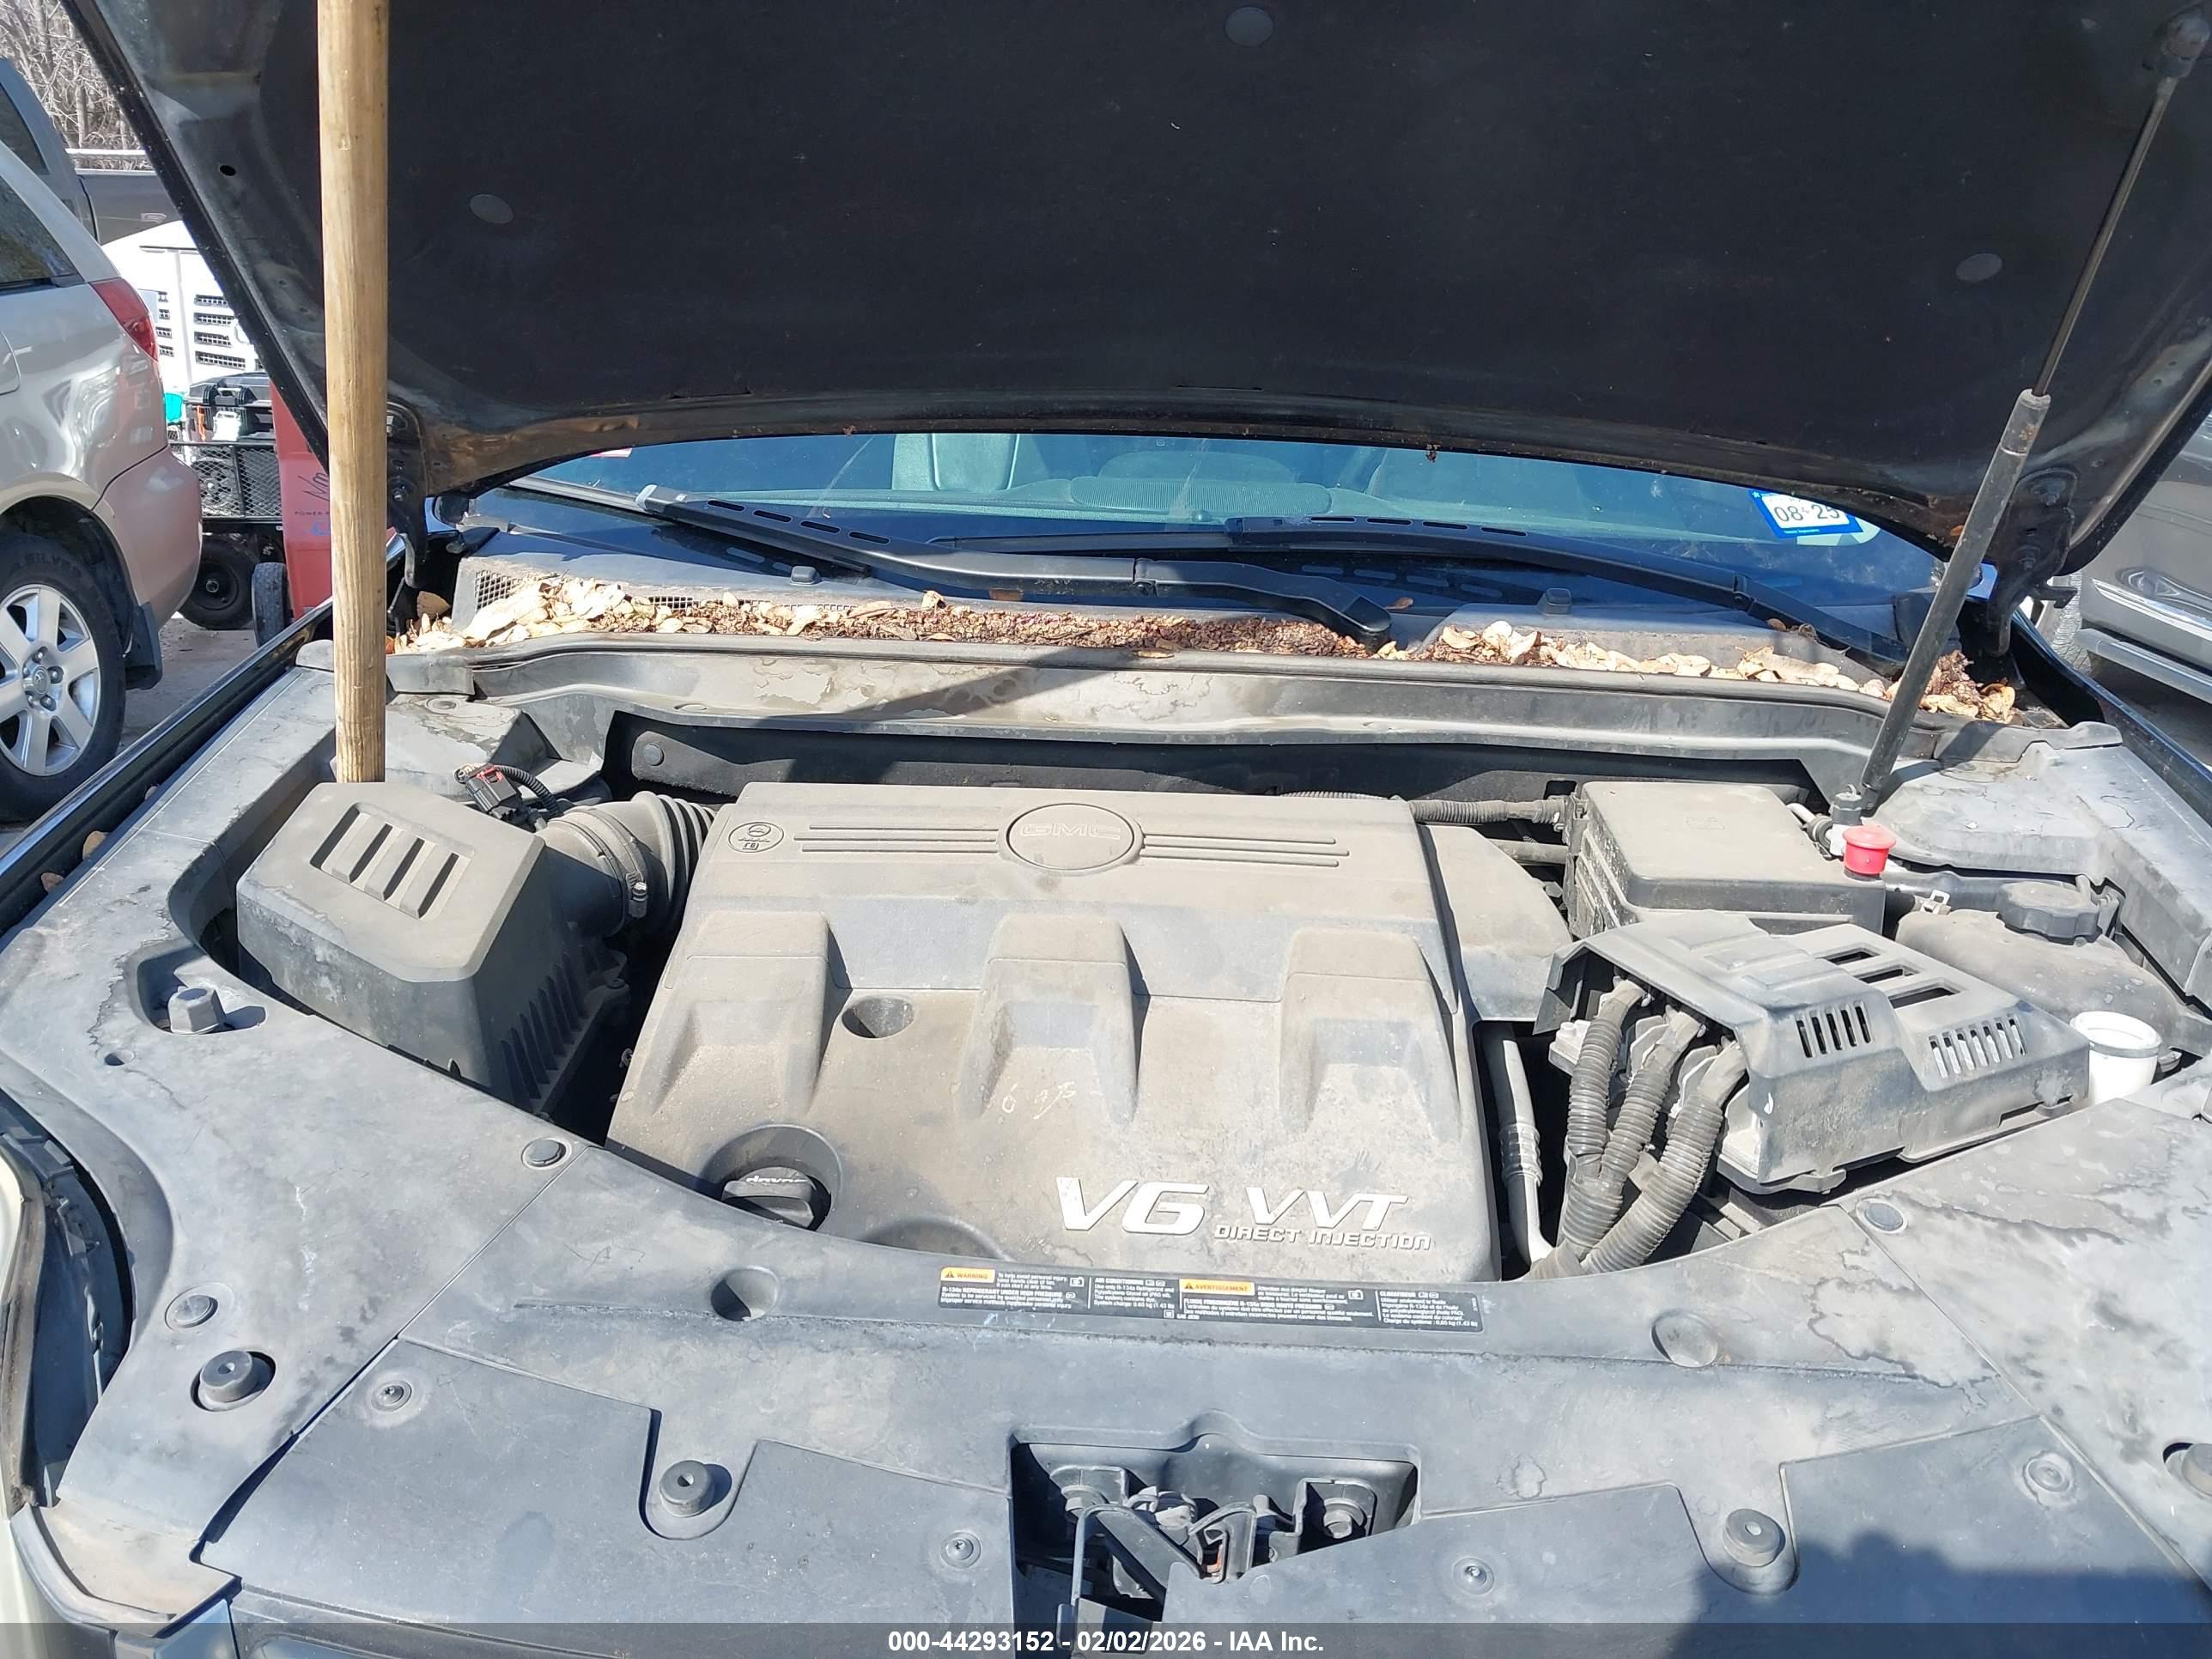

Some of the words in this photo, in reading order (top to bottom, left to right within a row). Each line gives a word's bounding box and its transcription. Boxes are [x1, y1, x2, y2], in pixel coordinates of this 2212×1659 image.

[1774, 506, 1804, 522] 08
[1020, 823, 1121, 841] GMC
[1055, 1176, 1209, 1235] V6
[1245, 1187, 1409, 1231] VVT
[1214, 1224, 1301, 1243] DIRECT
[1310, 1229, 1431, 1250] INJECTION
[1194, 1284, 1248, 1292] AVERTISSEMENT
